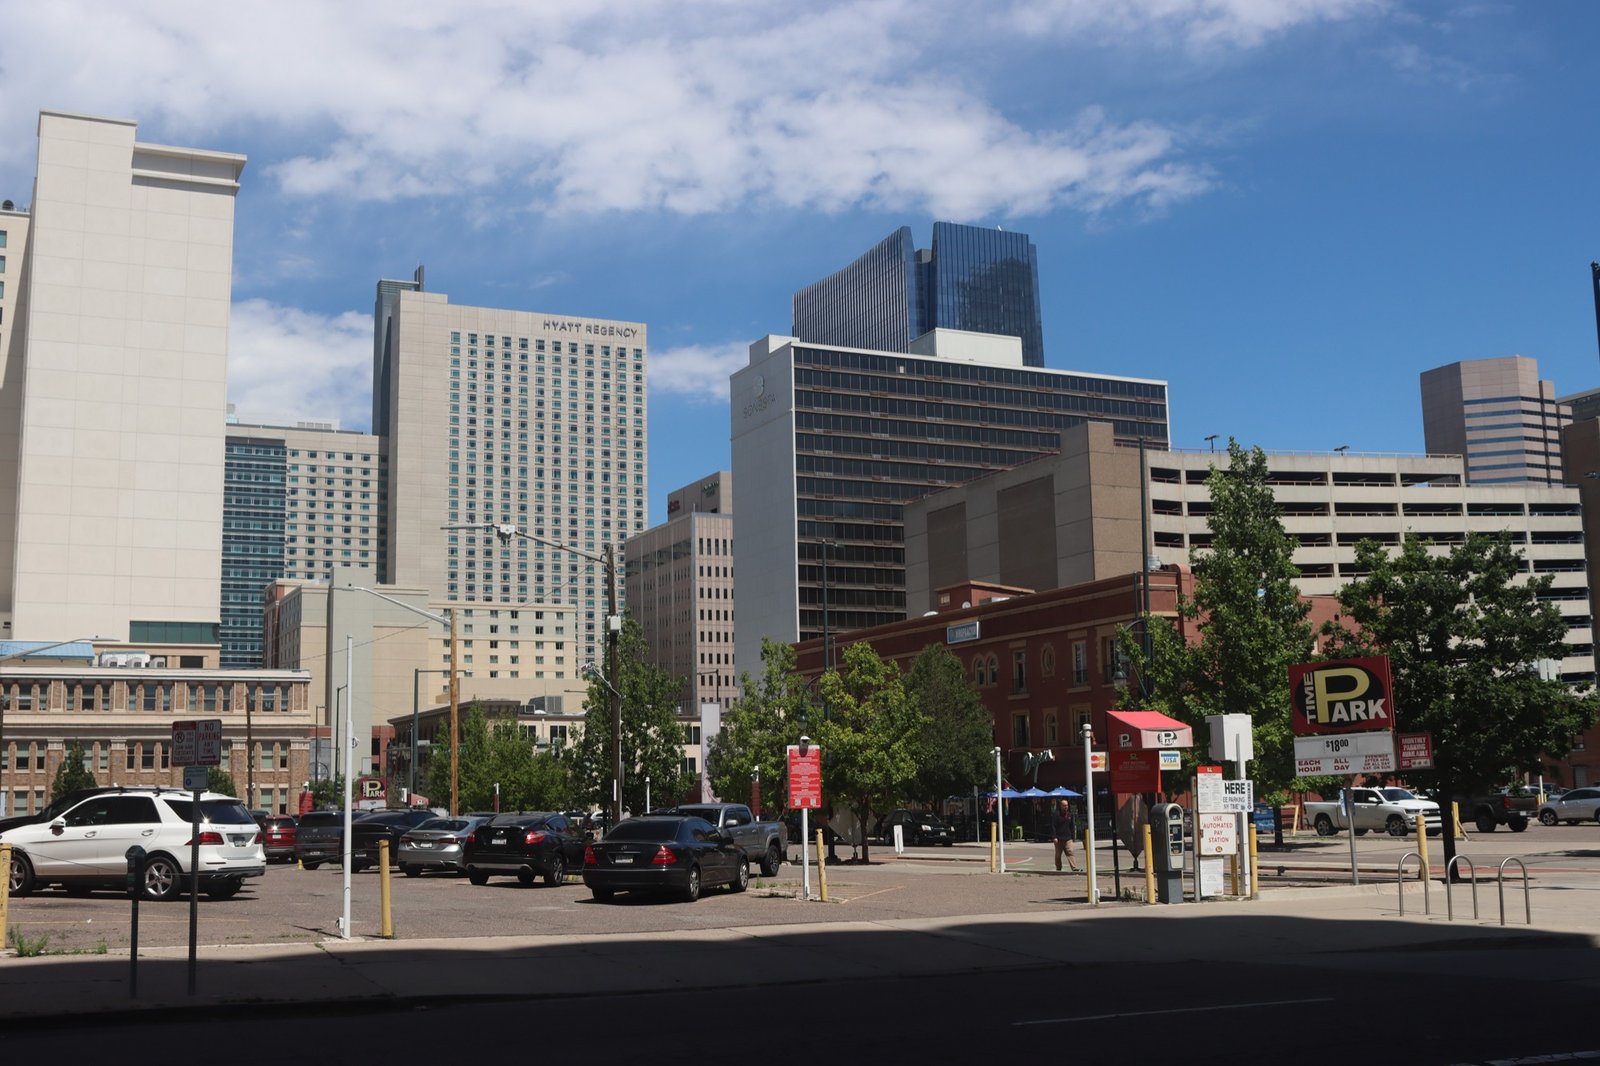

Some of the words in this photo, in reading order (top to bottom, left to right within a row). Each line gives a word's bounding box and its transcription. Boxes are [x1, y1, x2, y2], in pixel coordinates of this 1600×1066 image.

[543, 320, 581, 333] HYATT
[586, 325, 638, 339] REGENCY
[1303, 671, 1317, 725] TIME
[1313, 667, 1388, 724] PARK
[204, 723, 214, 731] NO
[198, 732, 220, 741] PARKING
[366, 781, 385, 797] PARK
[1224, 782, 1246, 794] HERE
